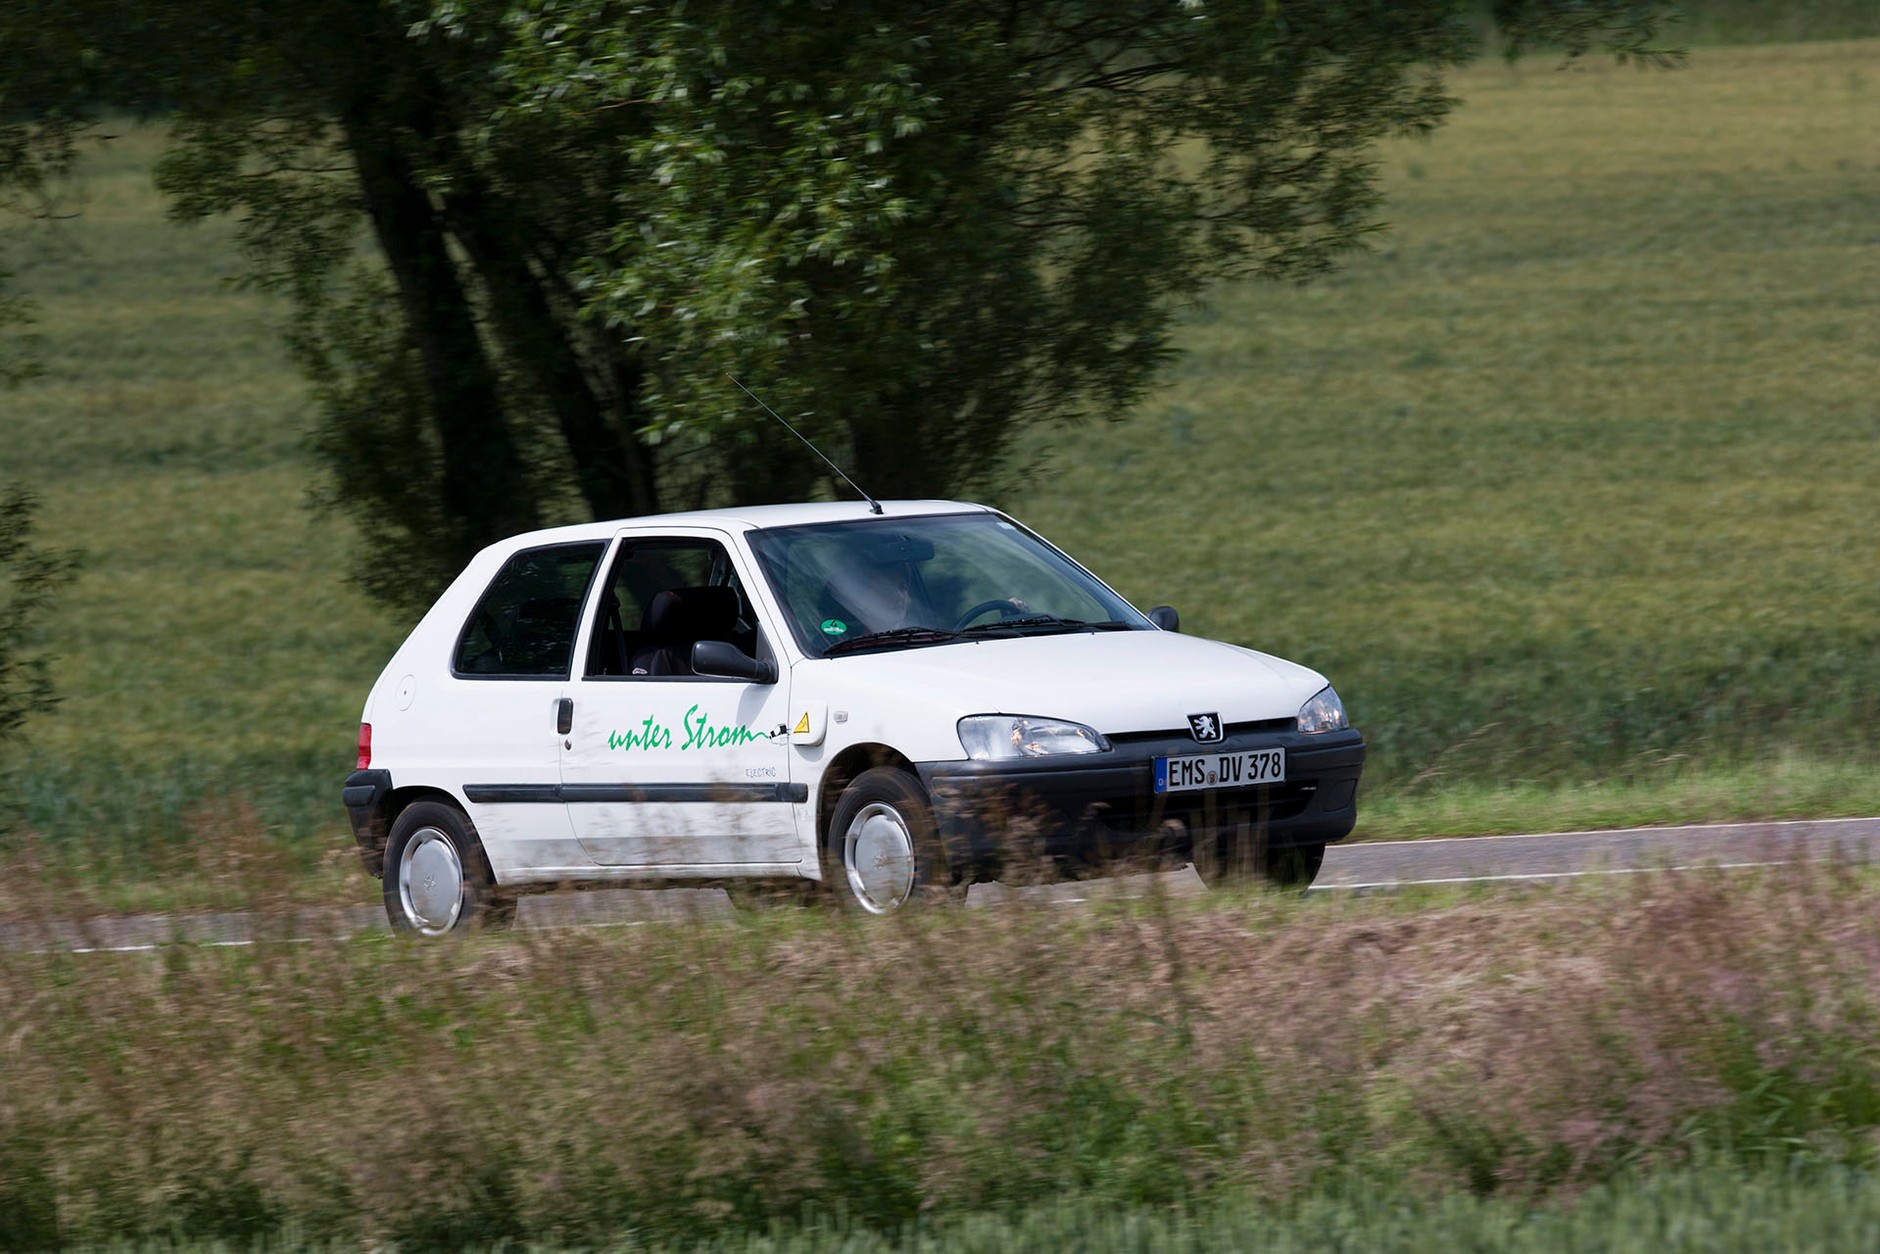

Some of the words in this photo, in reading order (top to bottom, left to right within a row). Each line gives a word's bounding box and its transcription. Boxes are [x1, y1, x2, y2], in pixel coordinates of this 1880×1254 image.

[608, 714, 672, 751] unter
[681, 704, 754, 751] Strom
[745, 766, 777, 778] ELECTRIC
[1169, 759, 1205, 787] EMS
[1219, 756, 1242, 783] DV
[1248, 752, 1281, 780] 378
